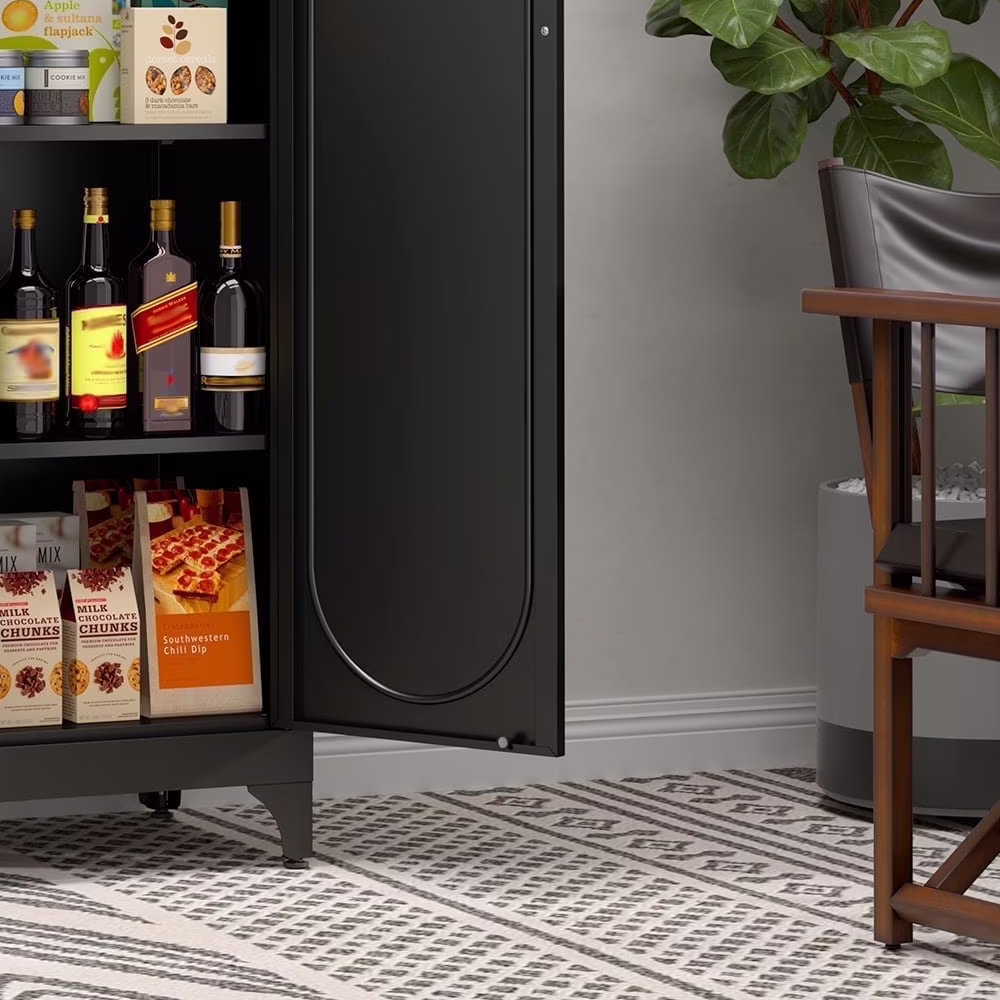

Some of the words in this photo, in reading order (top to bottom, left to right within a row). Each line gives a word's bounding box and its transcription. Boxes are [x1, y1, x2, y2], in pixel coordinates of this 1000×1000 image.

[44, 0, 80, 11] Apple
[44, 13, 53, 23] &
[57, 13, 102, 23] sultana
[44, 26, 93, 38] flapjack
[38, 546, 61, 563] MIX
[0, 608, 30, 617] MILK
[77, 604, 108, 613] MILK
[0, 616, 60, 626] CHOCOLATE
[78, 612, 137, 622] CHOCOLATE
[0, 626, 60, 638] CHUNKS
[79, 622, 138, 634] CHUNKS
[162, 634, 230, 645] Southwestern
[163, 645, 187, 655] Chili
[191, 645, 207, 655] Dip
